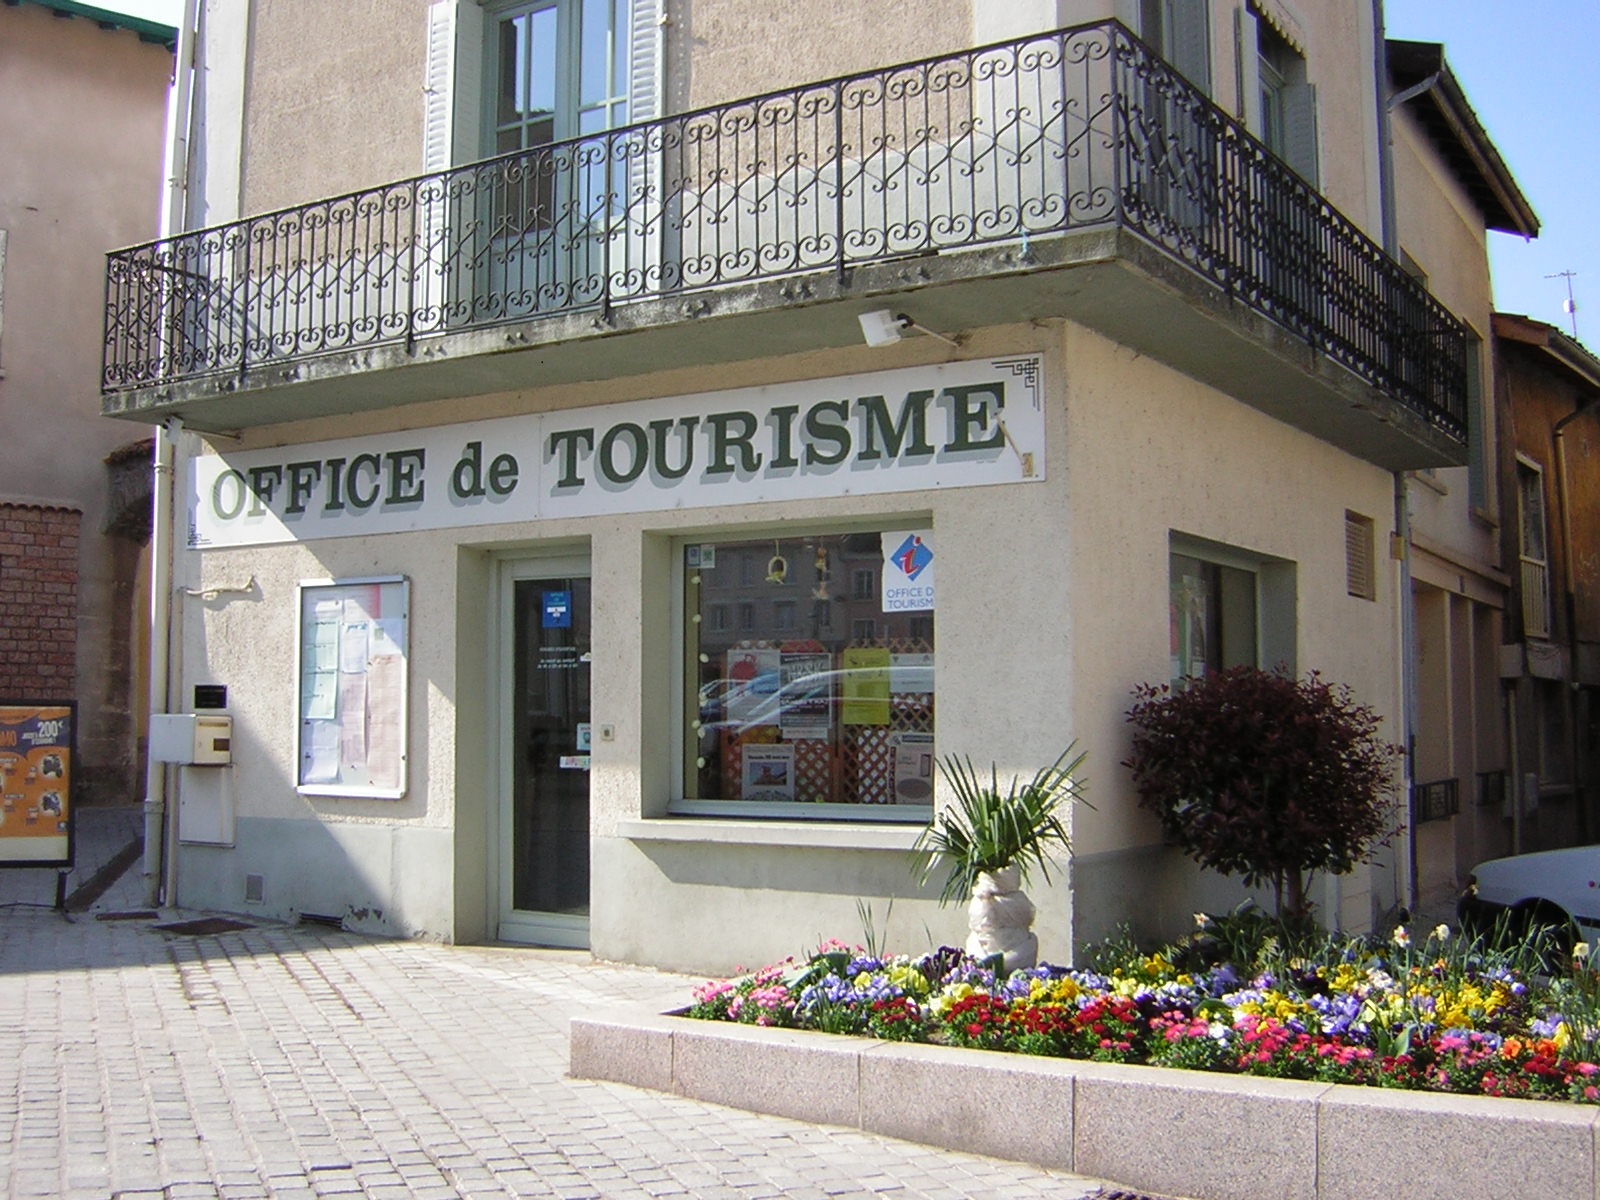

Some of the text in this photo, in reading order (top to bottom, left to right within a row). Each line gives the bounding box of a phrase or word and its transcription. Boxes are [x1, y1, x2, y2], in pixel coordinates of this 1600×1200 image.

[212, 380, 1006, 521] OFFICE de TOURISME
[887, 587, 923, 598] OFFICE
[887, 598, 934, 609] TOURISM
